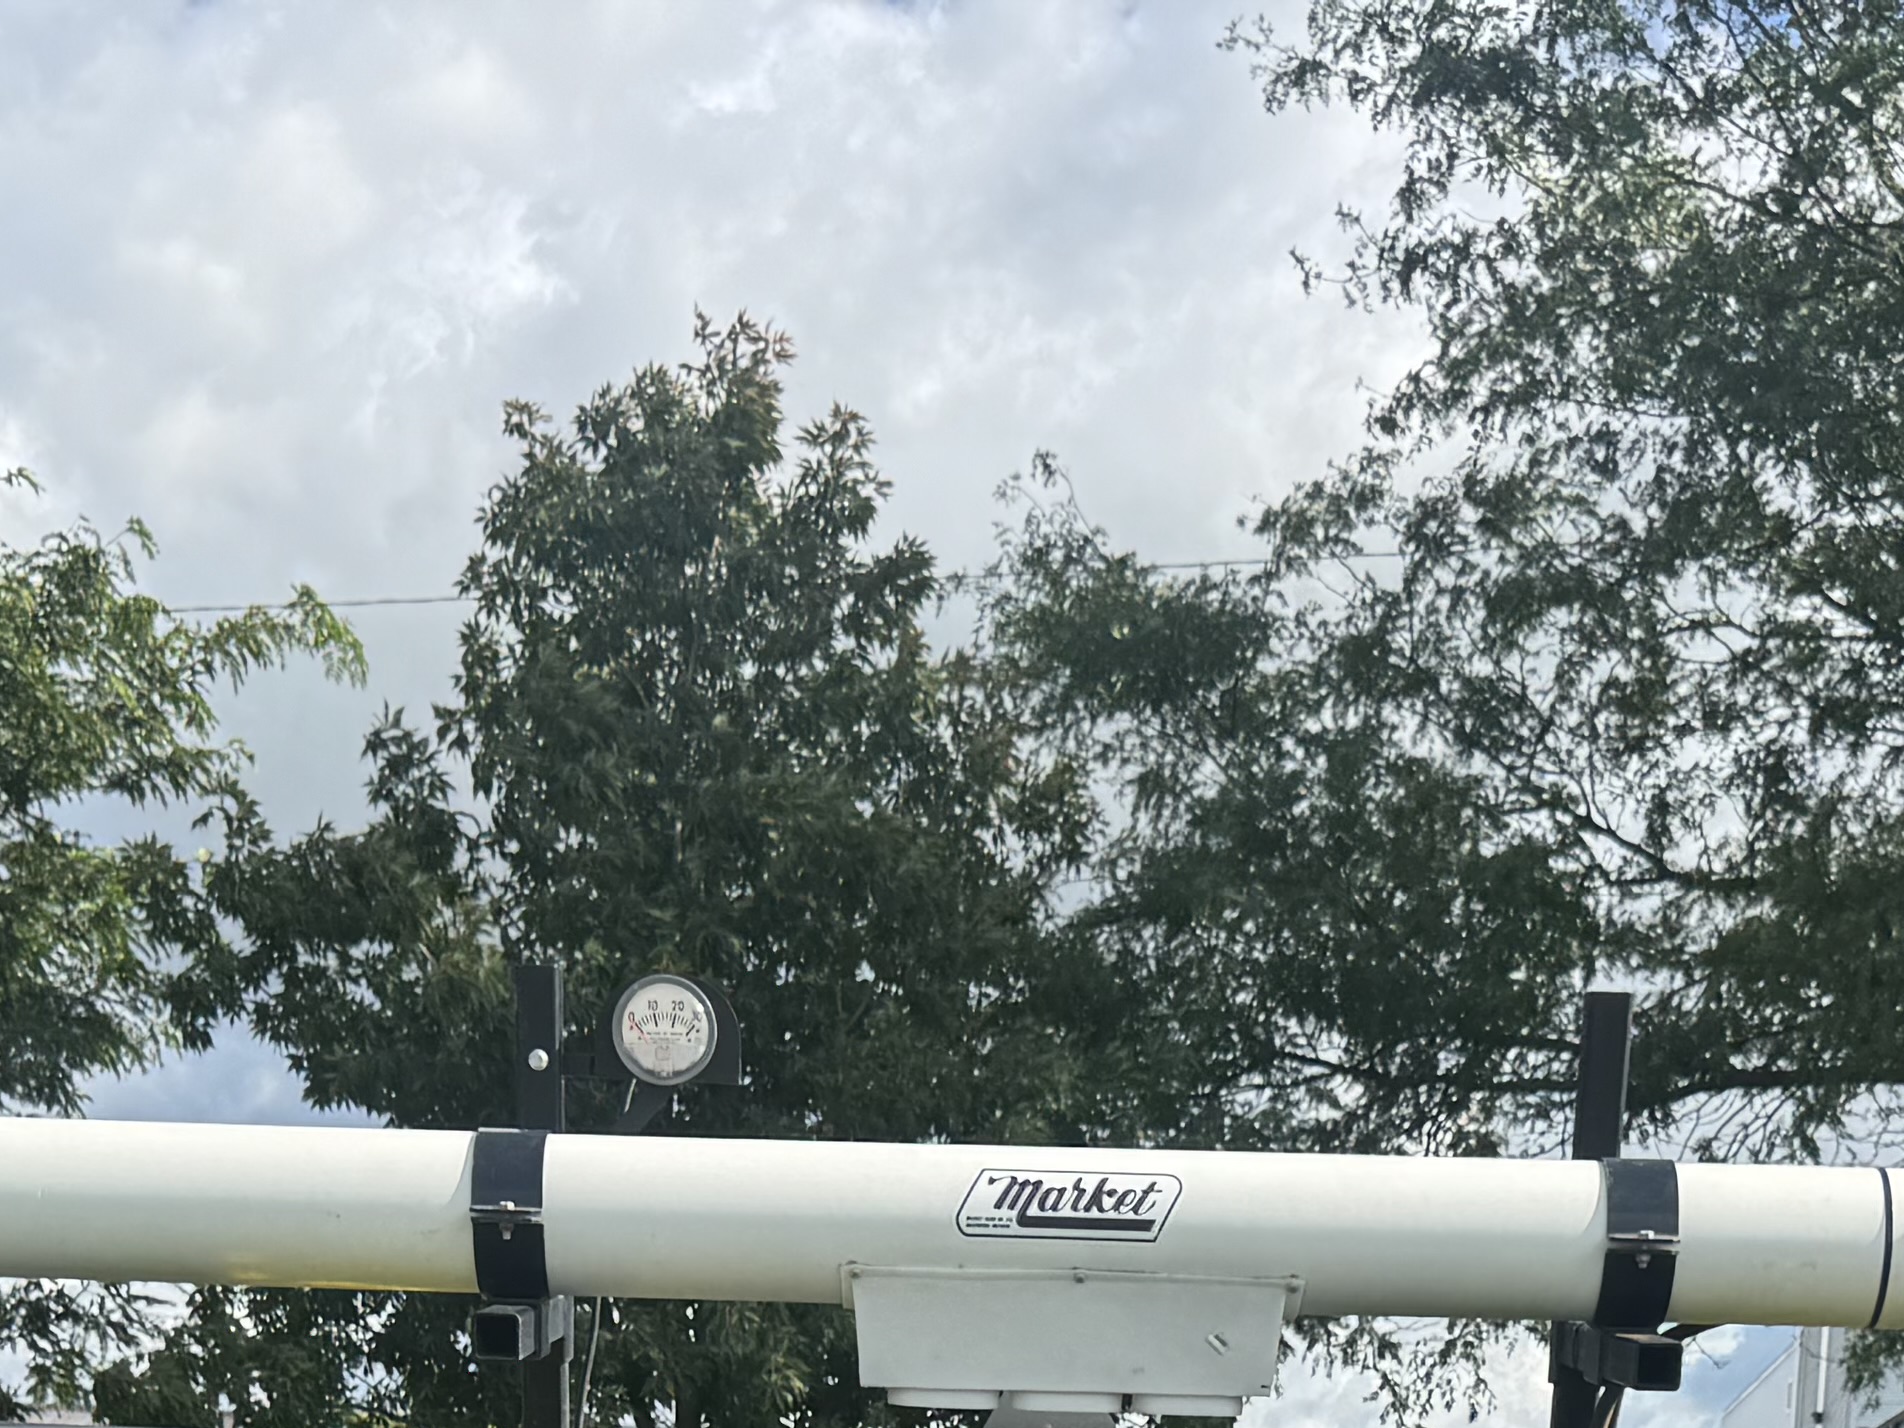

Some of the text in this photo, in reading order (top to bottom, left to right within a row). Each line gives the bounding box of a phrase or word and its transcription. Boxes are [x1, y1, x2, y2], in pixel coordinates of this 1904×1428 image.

[647, 1000, 684, 1011] 10 20
[988, 1175, 1163, 1217] Market
